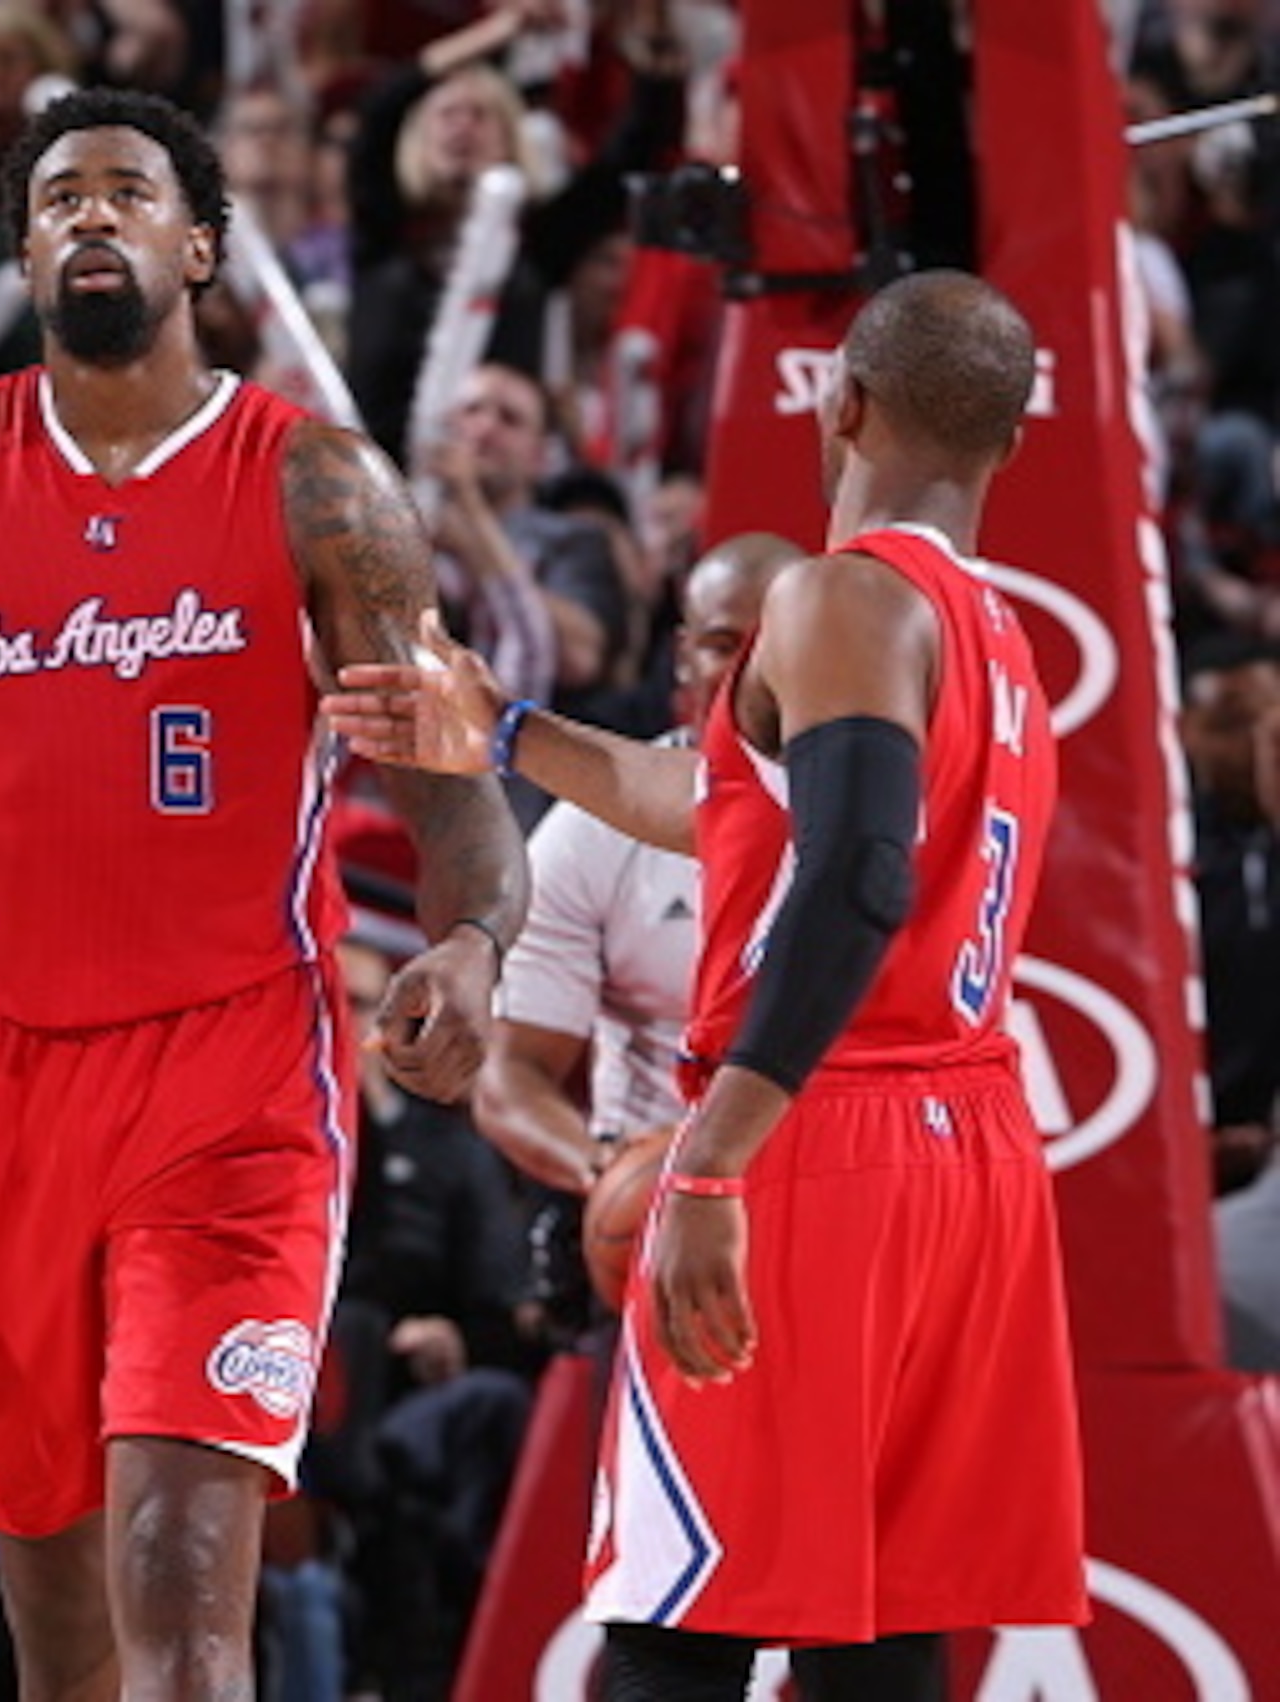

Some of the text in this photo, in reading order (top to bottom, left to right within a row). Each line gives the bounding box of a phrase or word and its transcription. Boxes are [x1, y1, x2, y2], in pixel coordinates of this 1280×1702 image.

[42, 587, 247, 680] Angeles
[149, 703, 213, 815] 6
[951, 805, 1019, 1028] 3
